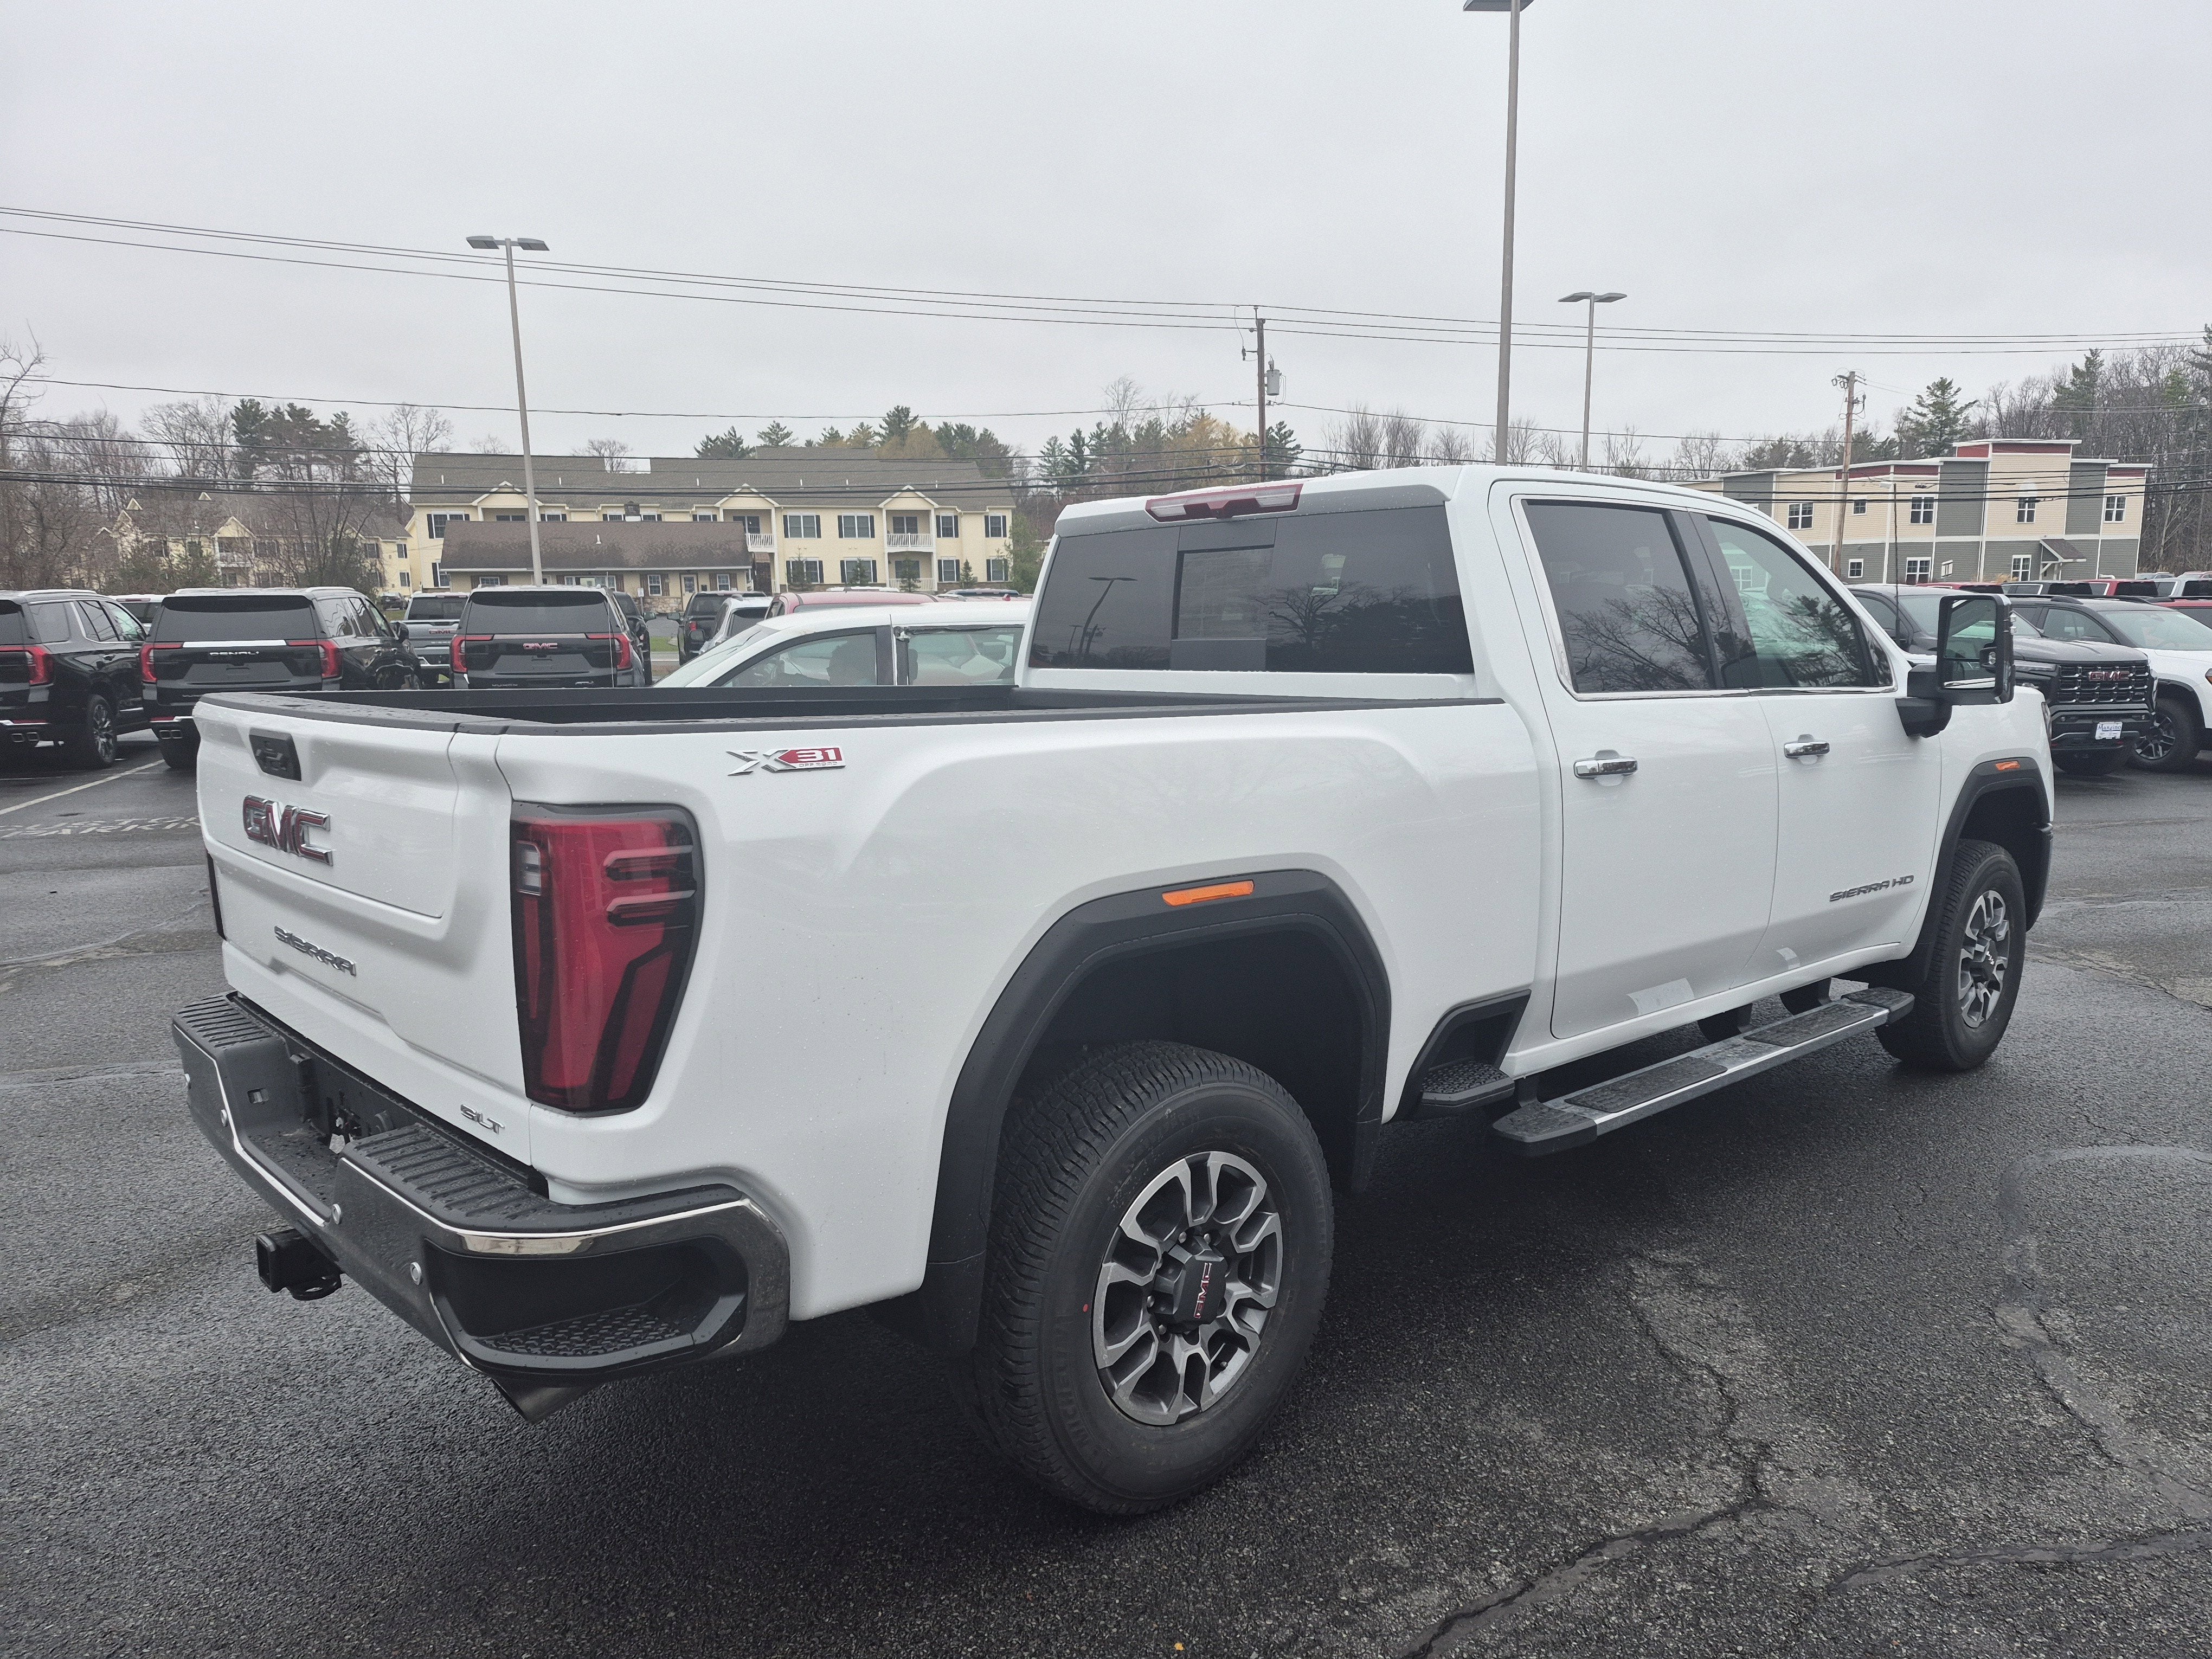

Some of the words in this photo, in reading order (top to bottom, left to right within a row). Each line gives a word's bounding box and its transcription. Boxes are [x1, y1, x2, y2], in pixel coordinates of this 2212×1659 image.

[2088, 671, 2130, 681] GMC
[243, 795, 333, 866] GMC
[1829, 880, 1891, 902] SIERRA
[1892, 874, 1915, 888] HD
[274, 925, 357, 976] SIERRA
[460, 1104, 505, 1134] SLT
[1193, 1262, 1213, 1319] GMC
